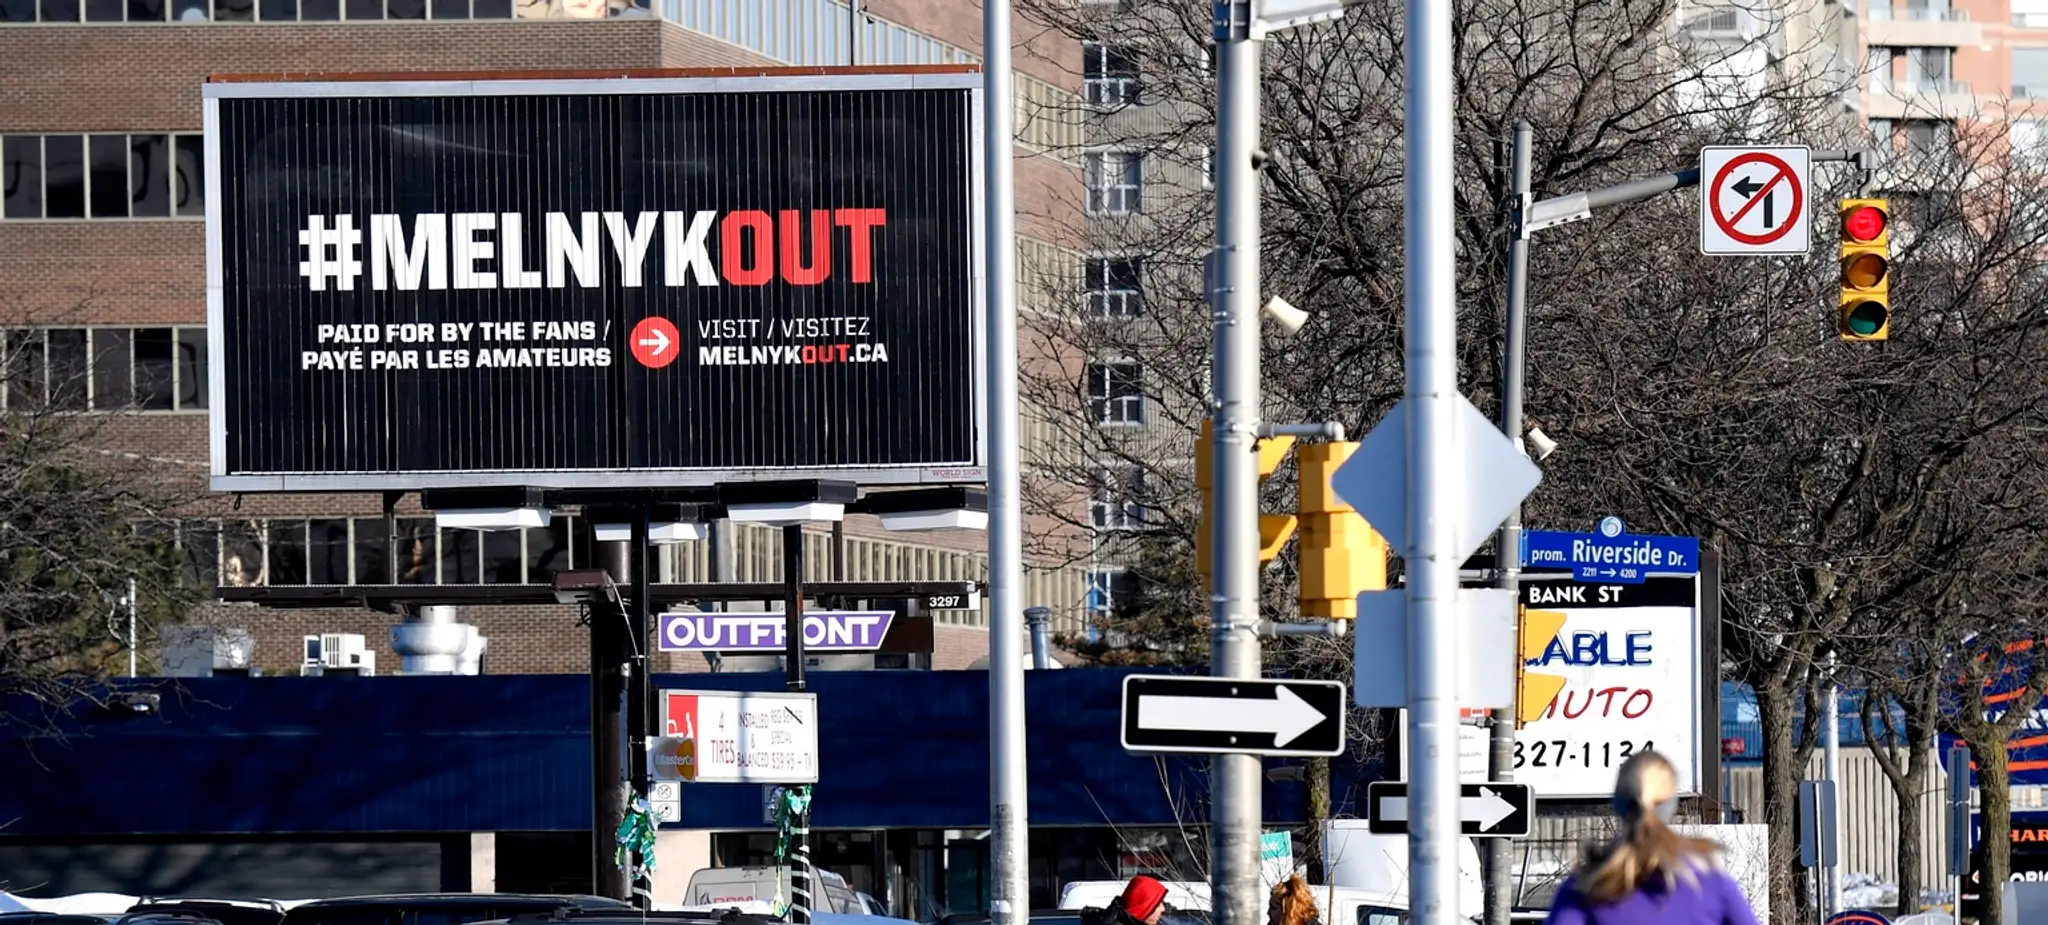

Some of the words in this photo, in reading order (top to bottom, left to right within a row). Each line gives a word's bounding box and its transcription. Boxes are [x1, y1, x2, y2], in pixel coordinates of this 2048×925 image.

[298, 208, 886, 291] #MELNYKOUT
[318, 323, 380, 344] PAID
[386, 322, 434, 343] FOR
[441, 321, 474, 342] BY
[479, 321, 525, 341] THE
[532, 320, 596, 340] FANS
[698, 318, 760, 339] VISIT
[781, 316, 870, 338] VISITEZ
[302, 346, 363, 371] PAYÉ
[371, 349, 419, 370] PAR
[426, 348, 470, 369] LES
[476, 347, 612, 369] AMATEURS
[699, 342, 889, 366] MELNYKOUT.CA
[1532, 549, 1567, 564] prom.
[1572, 538, 1662, 565] Riverside
[1668, 550, 1687, 567] Dr.
[1619, 568, 1637, 579] 4200
[929, 596, 960, 607] 3297
[1530, 586, 1587, 604] BANK
[1598, 585, 1624, 603] ST
[710, 739, 736, 765] TIRES
